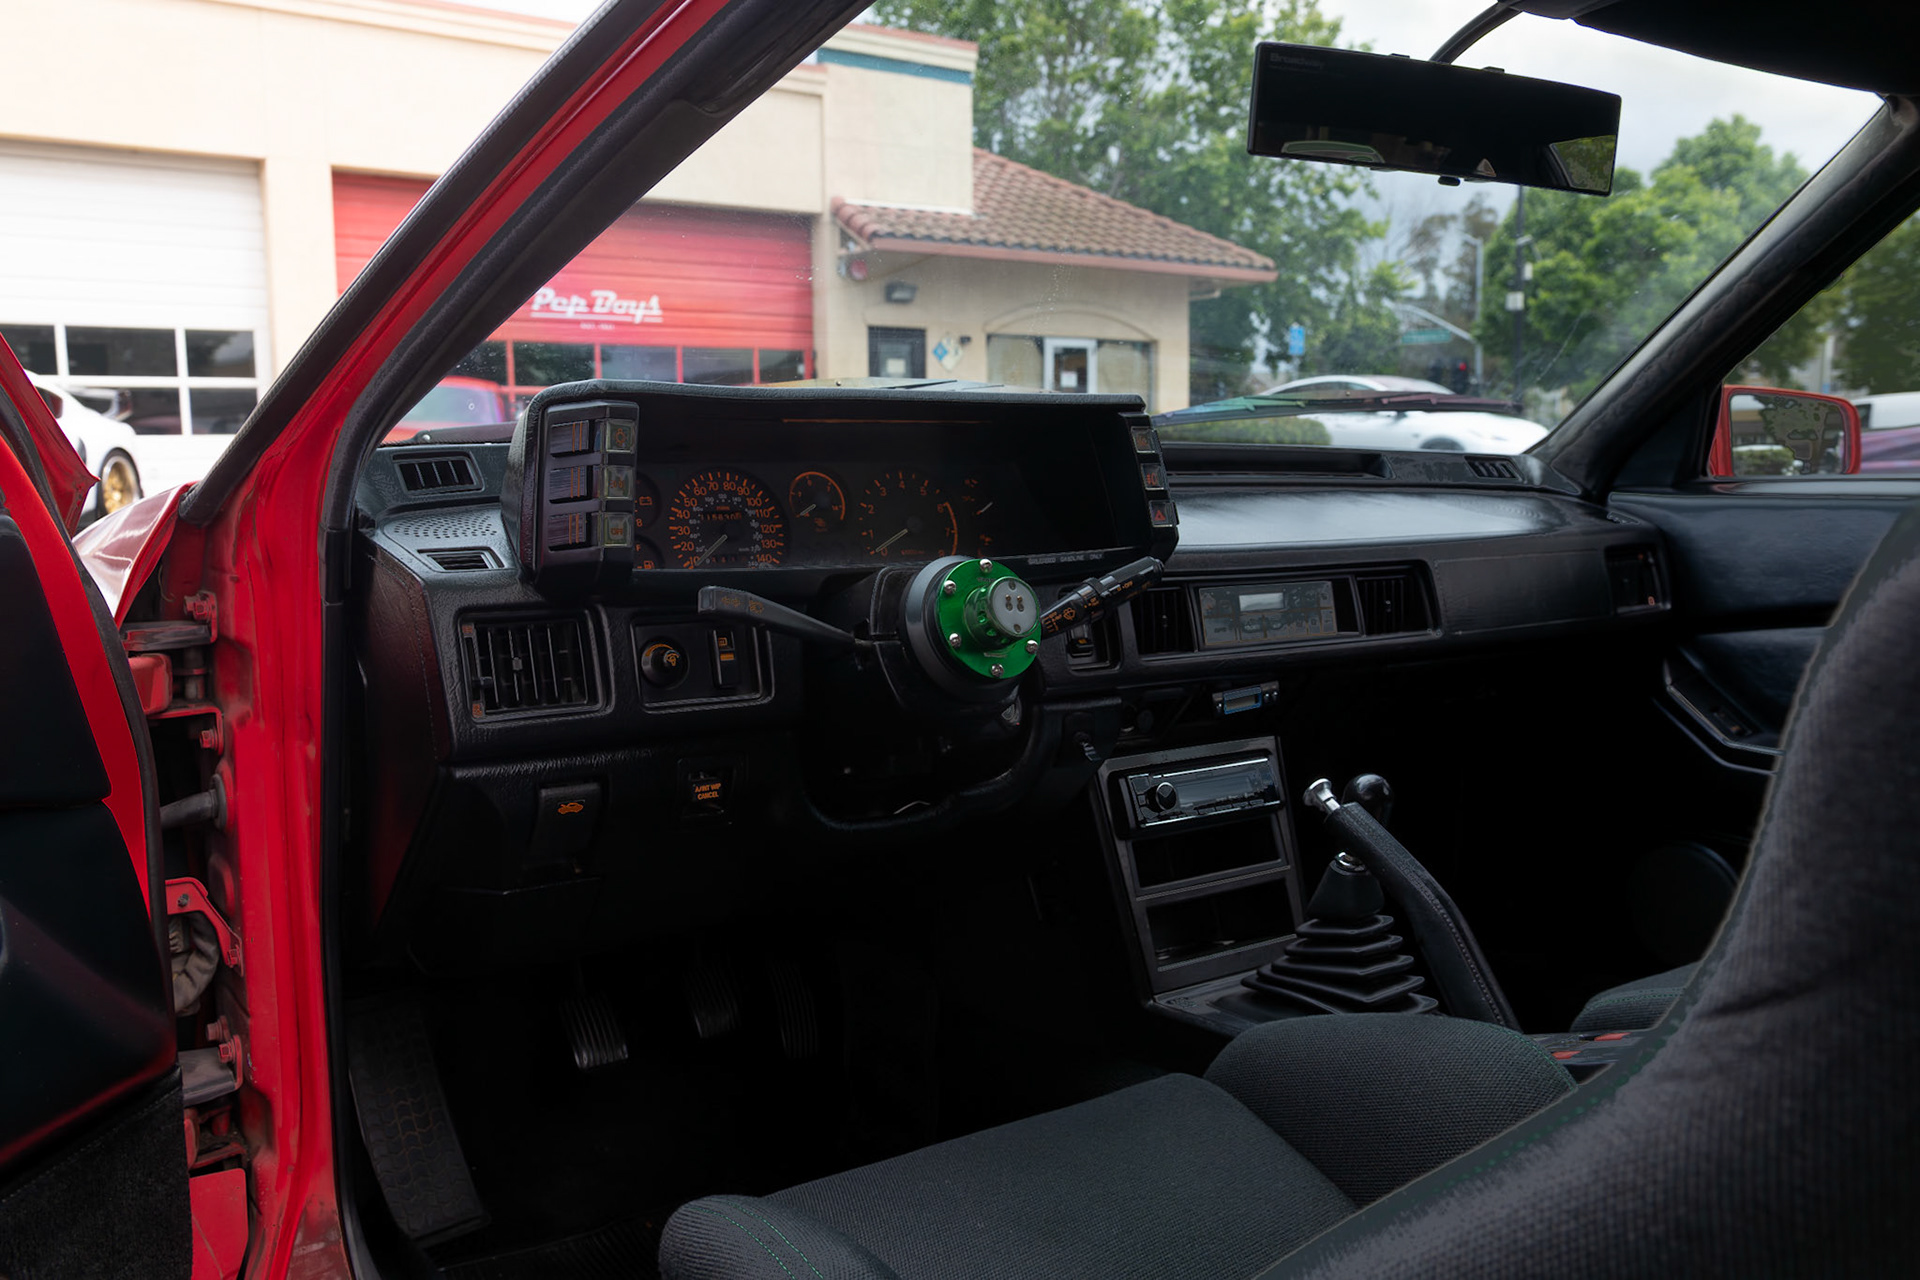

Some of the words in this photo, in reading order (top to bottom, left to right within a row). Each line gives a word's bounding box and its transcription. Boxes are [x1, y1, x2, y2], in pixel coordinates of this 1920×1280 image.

[531, 287, 589, 317] Pep
[591, 289, 663, 324] Boys
[693, 486, 707, 496] 60
[706, 481, 719, 491] 70
[723, 481, 736, 491] 80
[737, 486, 750, 496] 90
[920, 486, 927, 496] 5
[880, 486, 887, 497] 3
[684, 498, 698, 508] 50
[746, 497, 762, 507] 100
[677, 509, 690, 519] 40
[755, 510, 770, 518] 110
[868, 504, 875, 514] 2
[677, 525, 691, 535] 30
[760, 524, 776, 533] 120
[680, 541, 694, 551] 20
[760, 540, 776, 549] 130
[756, 554, 773, 564] 140
[697, 791, 719, 800] CANCEL
